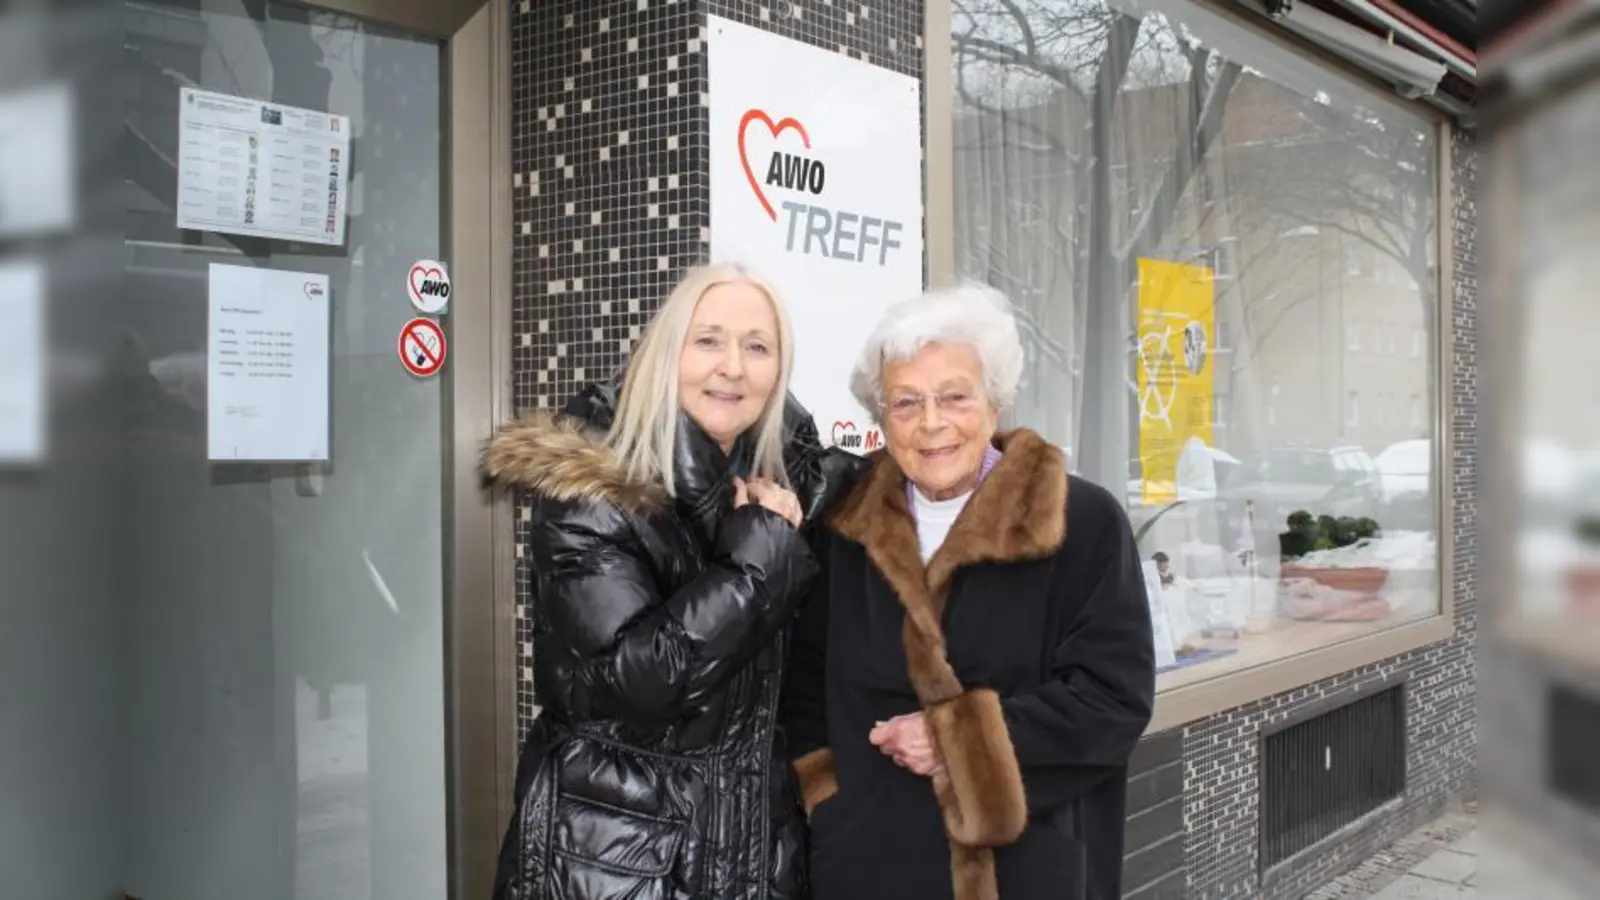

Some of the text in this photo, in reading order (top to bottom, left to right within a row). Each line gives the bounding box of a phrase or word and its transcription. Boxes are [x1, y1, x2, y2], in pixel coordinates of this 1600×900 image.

[766, 151, 825, 195] AWO
[781, 200, 903, 266] TREFF
[420, 279, 449, 298] AWO
[840, 433, 862, 448] AWO
